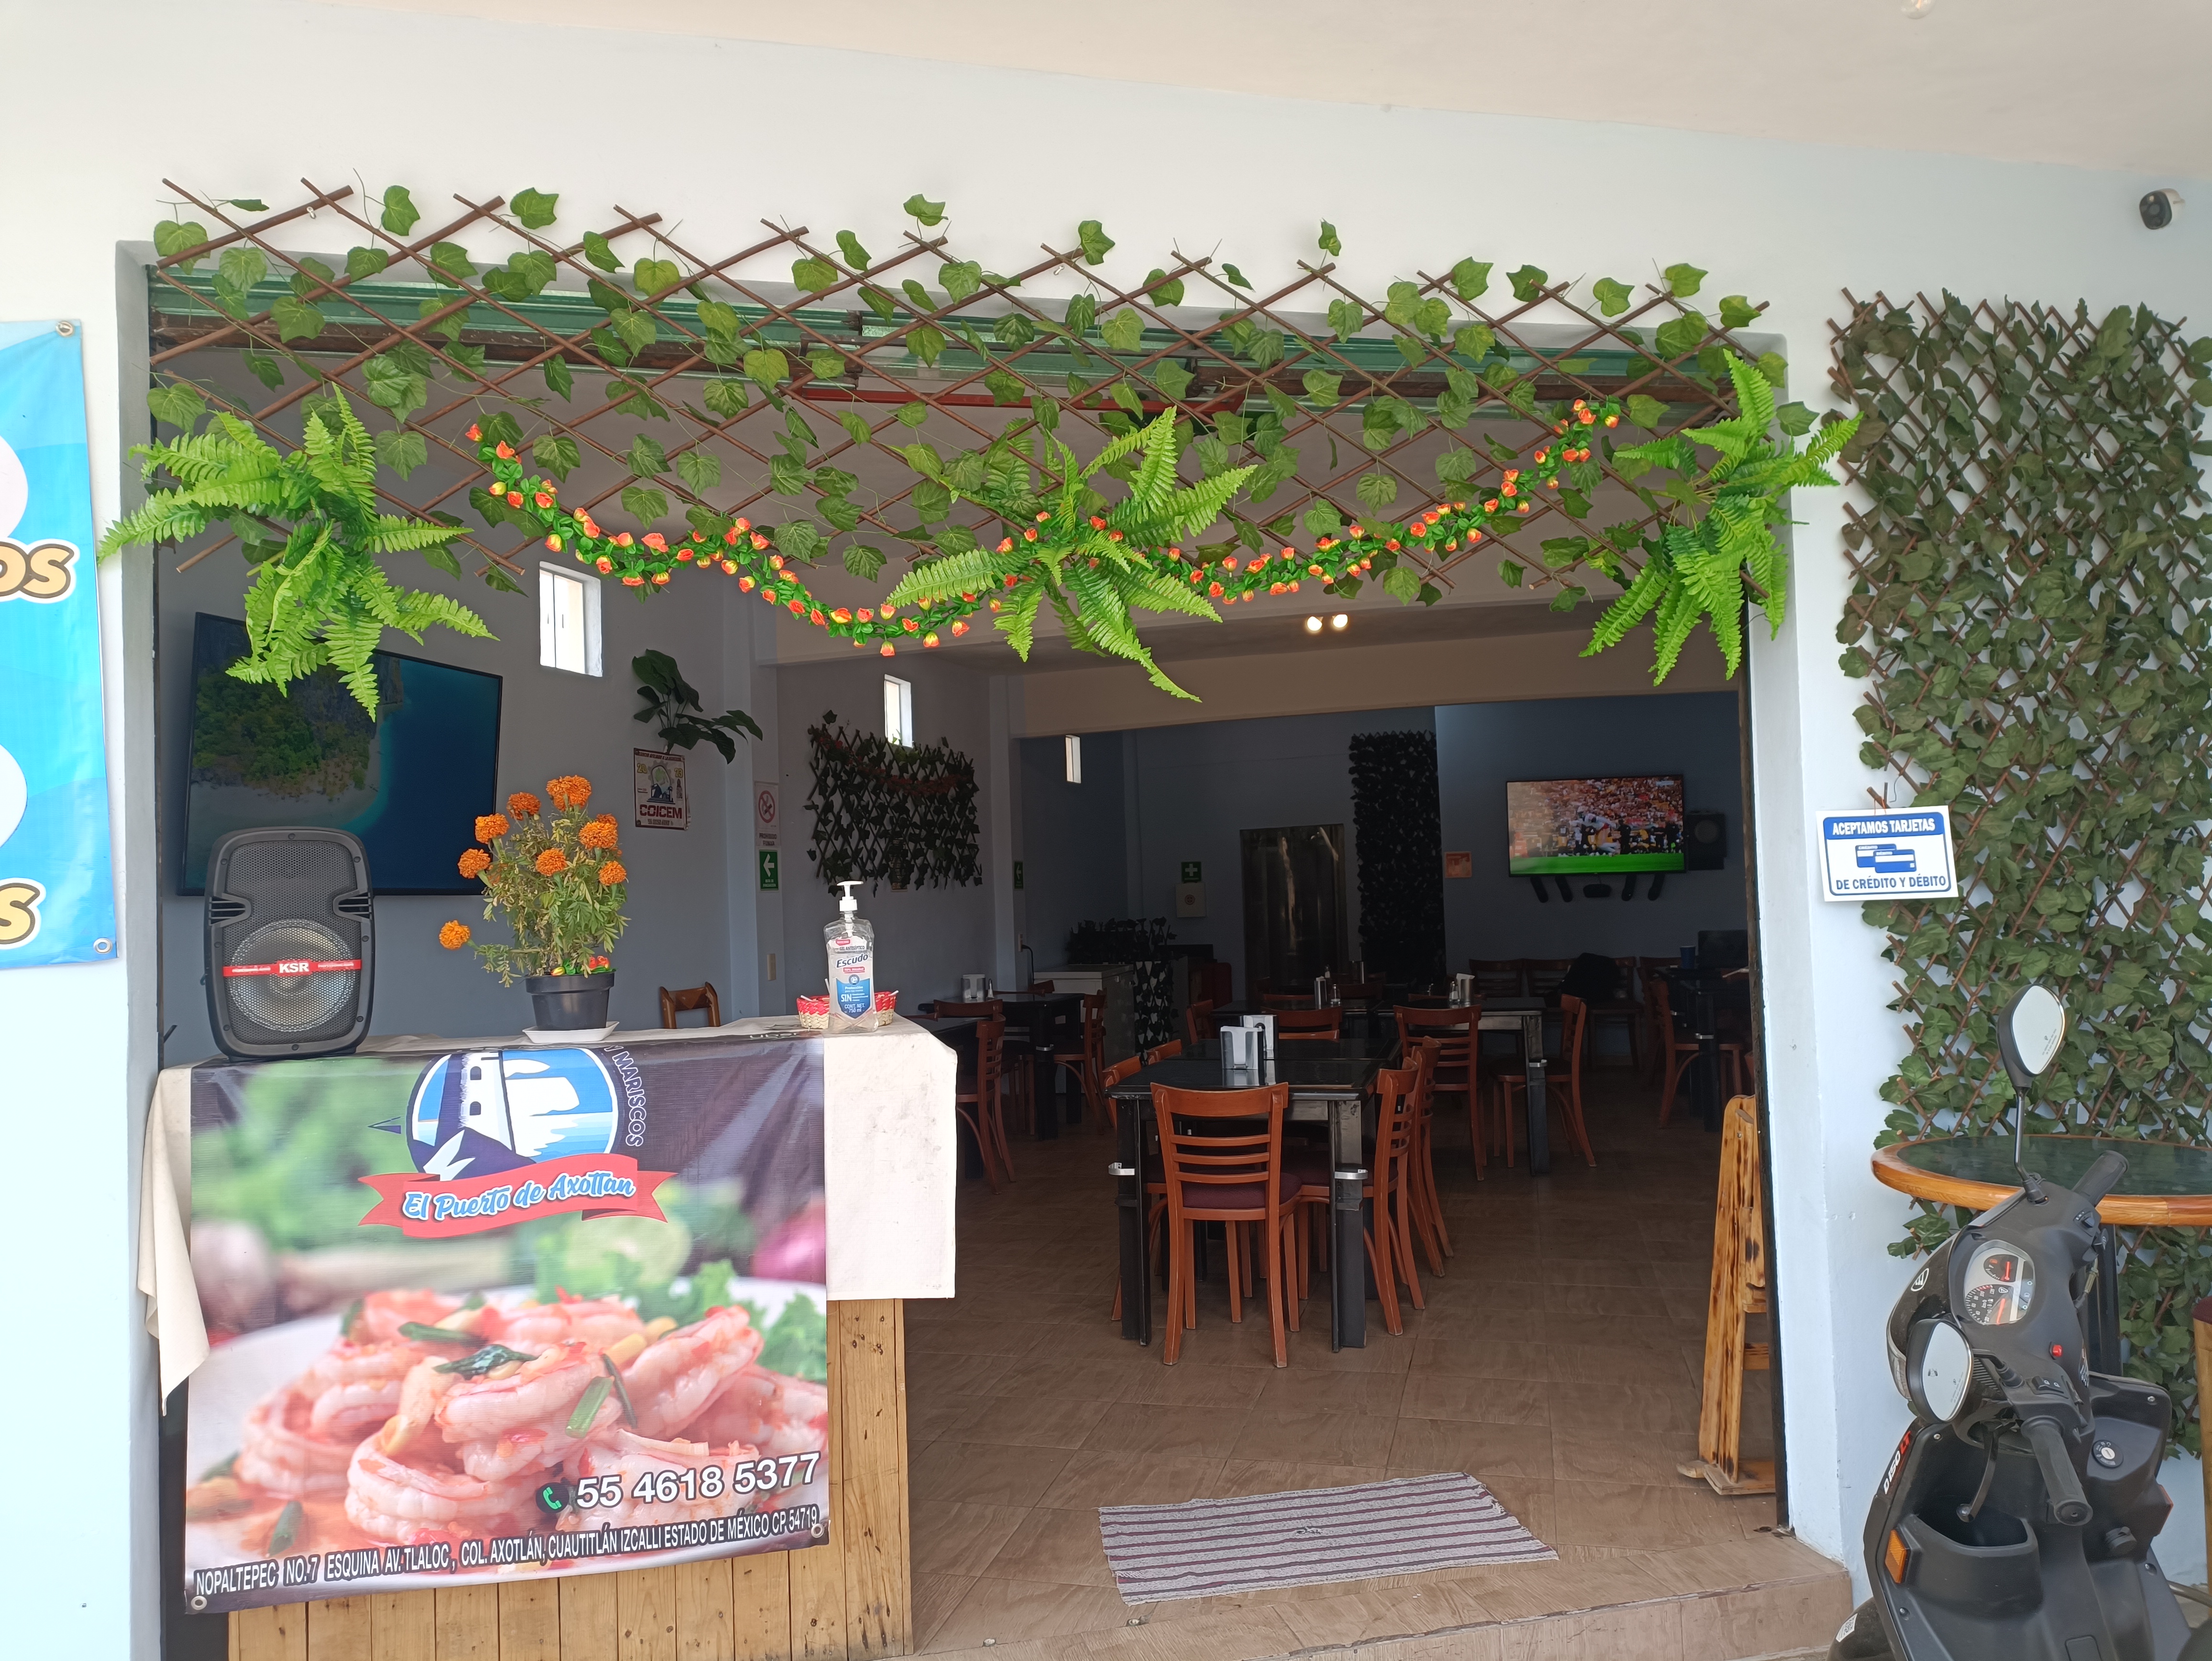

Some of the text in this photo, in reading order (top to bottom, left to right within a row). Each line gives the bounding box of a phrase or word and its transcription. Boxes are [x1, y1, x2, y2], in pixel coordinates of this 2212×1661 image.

[637, 763, 647, 774] 20
[675, 768, 683, 778] 23
[640, 804, 682, 819] COICEM
[1833, 818, 1936, 835] ACEPTAMOS TARJETAS
[1836, 874, 1947, 890] DE CRÉDITO Y DÉBITO
[836, 953, 869, 968] Escudo
[278, 963, 310, 974] KSR
[841, 994, 852, 1002] SIN
[612, 1051, 647, 1147] MARISCOS
[404, 1193, 431, 1219] El
[434, 1186, 511, 1219] Puerto
[514, 1182, 545, 1207] de
[576, 1451, 821, 1508] 55 4618 5377
[196, 1561, 276, 1595] NOPALTEPEC
[327, 1550, 379, 1578] ESQUINA
[461, 1541, 487, 1566] COL.
[490, 1530, 545, 1563] AXOTLÁN,
[548, 1524, 618, 1559] CUAUTITLÁN
[620, 1527, 661, 1552] IZCALLI
[664, 1521, 707, 1547] ESTADO
[710, 1519, 724, 1542] DE
[727, 1510, 769, 1540] MÉXICO
[788, 1506, 817, 1531] 54719
